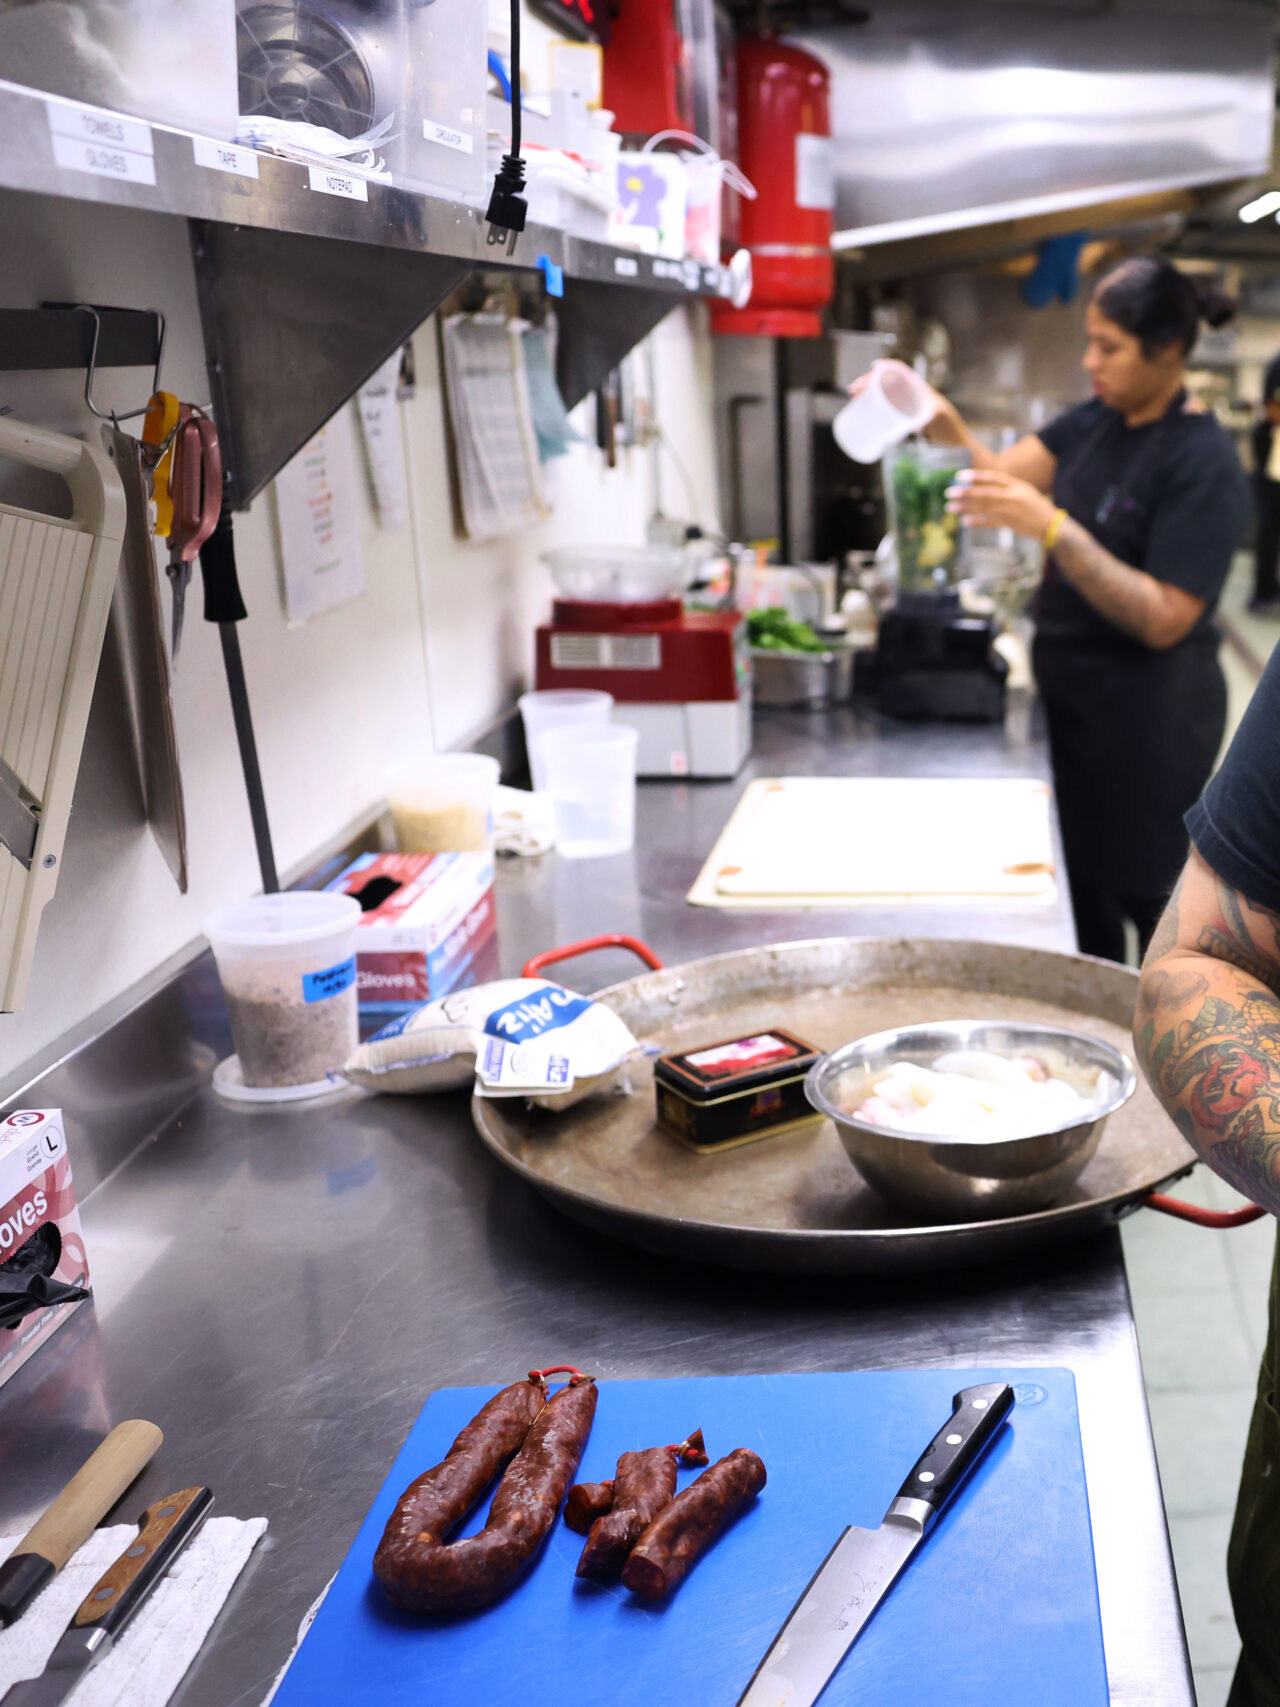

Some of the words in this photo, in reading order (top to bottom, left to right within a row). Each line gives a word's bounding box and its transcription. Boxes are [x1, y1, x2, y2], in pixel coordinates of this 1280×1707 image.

[217, 149, 238, 168] TAPE
[326, 175, 353, 194] NOTEPAD
[356, 970, 417, 989] Gloves
[45, 1135, 59, 1153] L
